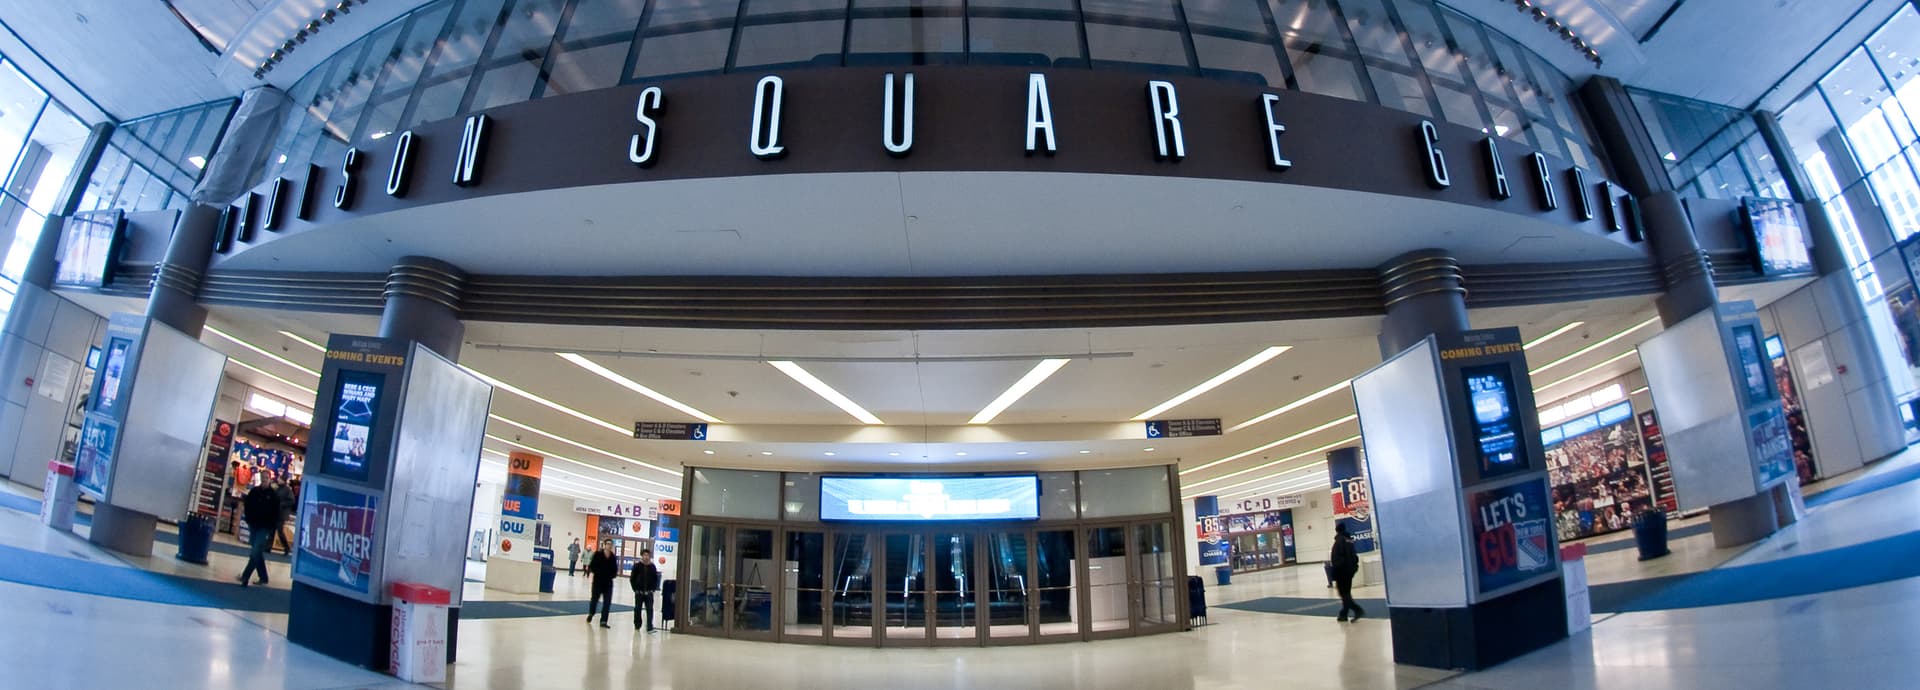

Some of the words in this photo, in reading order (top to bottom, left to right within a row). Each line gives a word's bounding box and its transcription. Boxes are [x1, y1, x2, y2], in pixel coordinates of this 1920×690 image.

[628, 72, 1293, 172] SQUARE
[1414, 119, 1645, 244] GARDEN
[327, 350, 363, 362] COMING
[366, 354, 404, 366] EVENTS
[1441, 347, 1482, 359] COMING
[1485, 343, 1521, 354] EVENTS
[1348, 481, 1368, 503] 85
[504, 501, 520, 512] WE
[614, 504, 622, 515] A
[633, 506, 641, 517] B
[1244, 500, 1252, 511] C
[1263, 498, 1271, 509] D
[330, 510, 348, 529] AM
[1481, 492, 1526, 532] LET'S
[1205, 518, 1219, 532] 85
[316, 528, 370, 560] RANGER
[1480, 522, 1516, 573] GO
[391, 608, 400, 676] recycle
